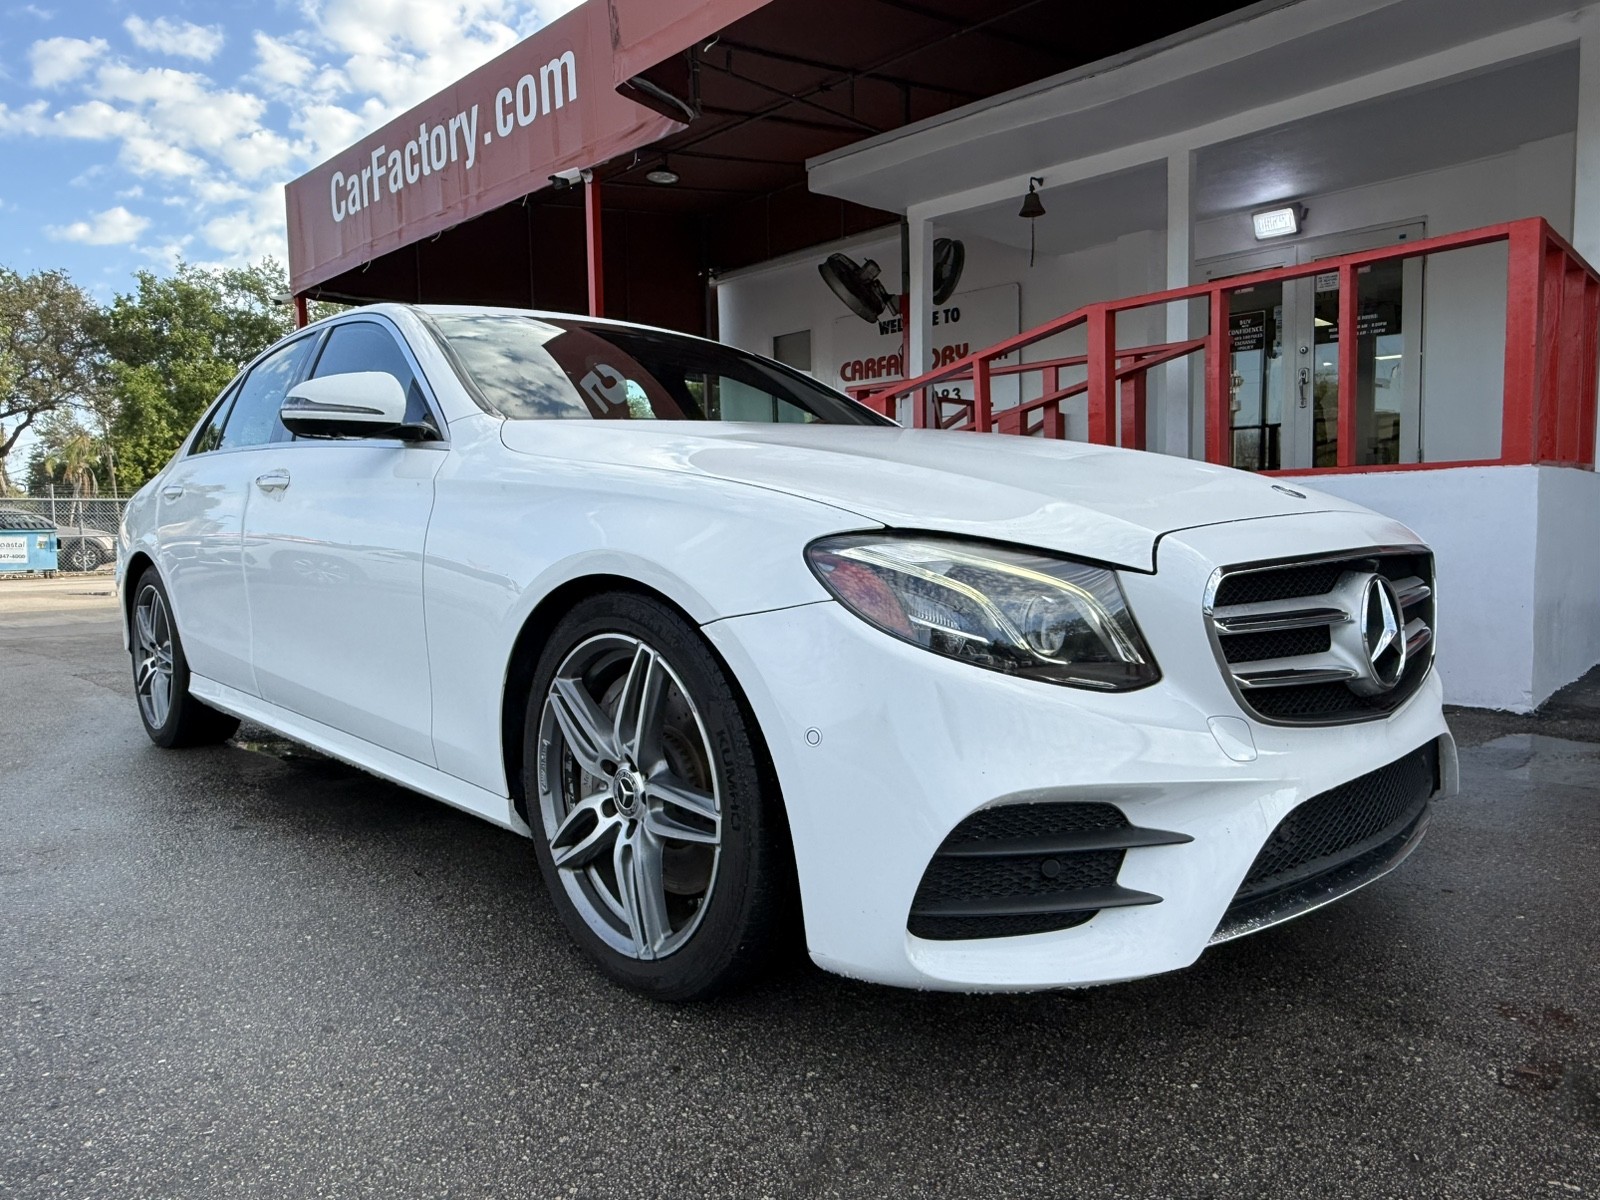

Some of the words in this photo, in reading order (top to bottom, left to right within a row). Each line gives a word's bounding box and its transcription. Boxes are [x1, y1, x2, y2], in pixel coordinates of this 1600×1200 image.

[330, 50, 577, 222] CarFactory.com
[879, 311, 939, 335] WELE
[943, 307, 961, 324] TO
[1228, 325, 1263, 336] CONFIDENCE
[716, 730, 740, 831] KUMHO
